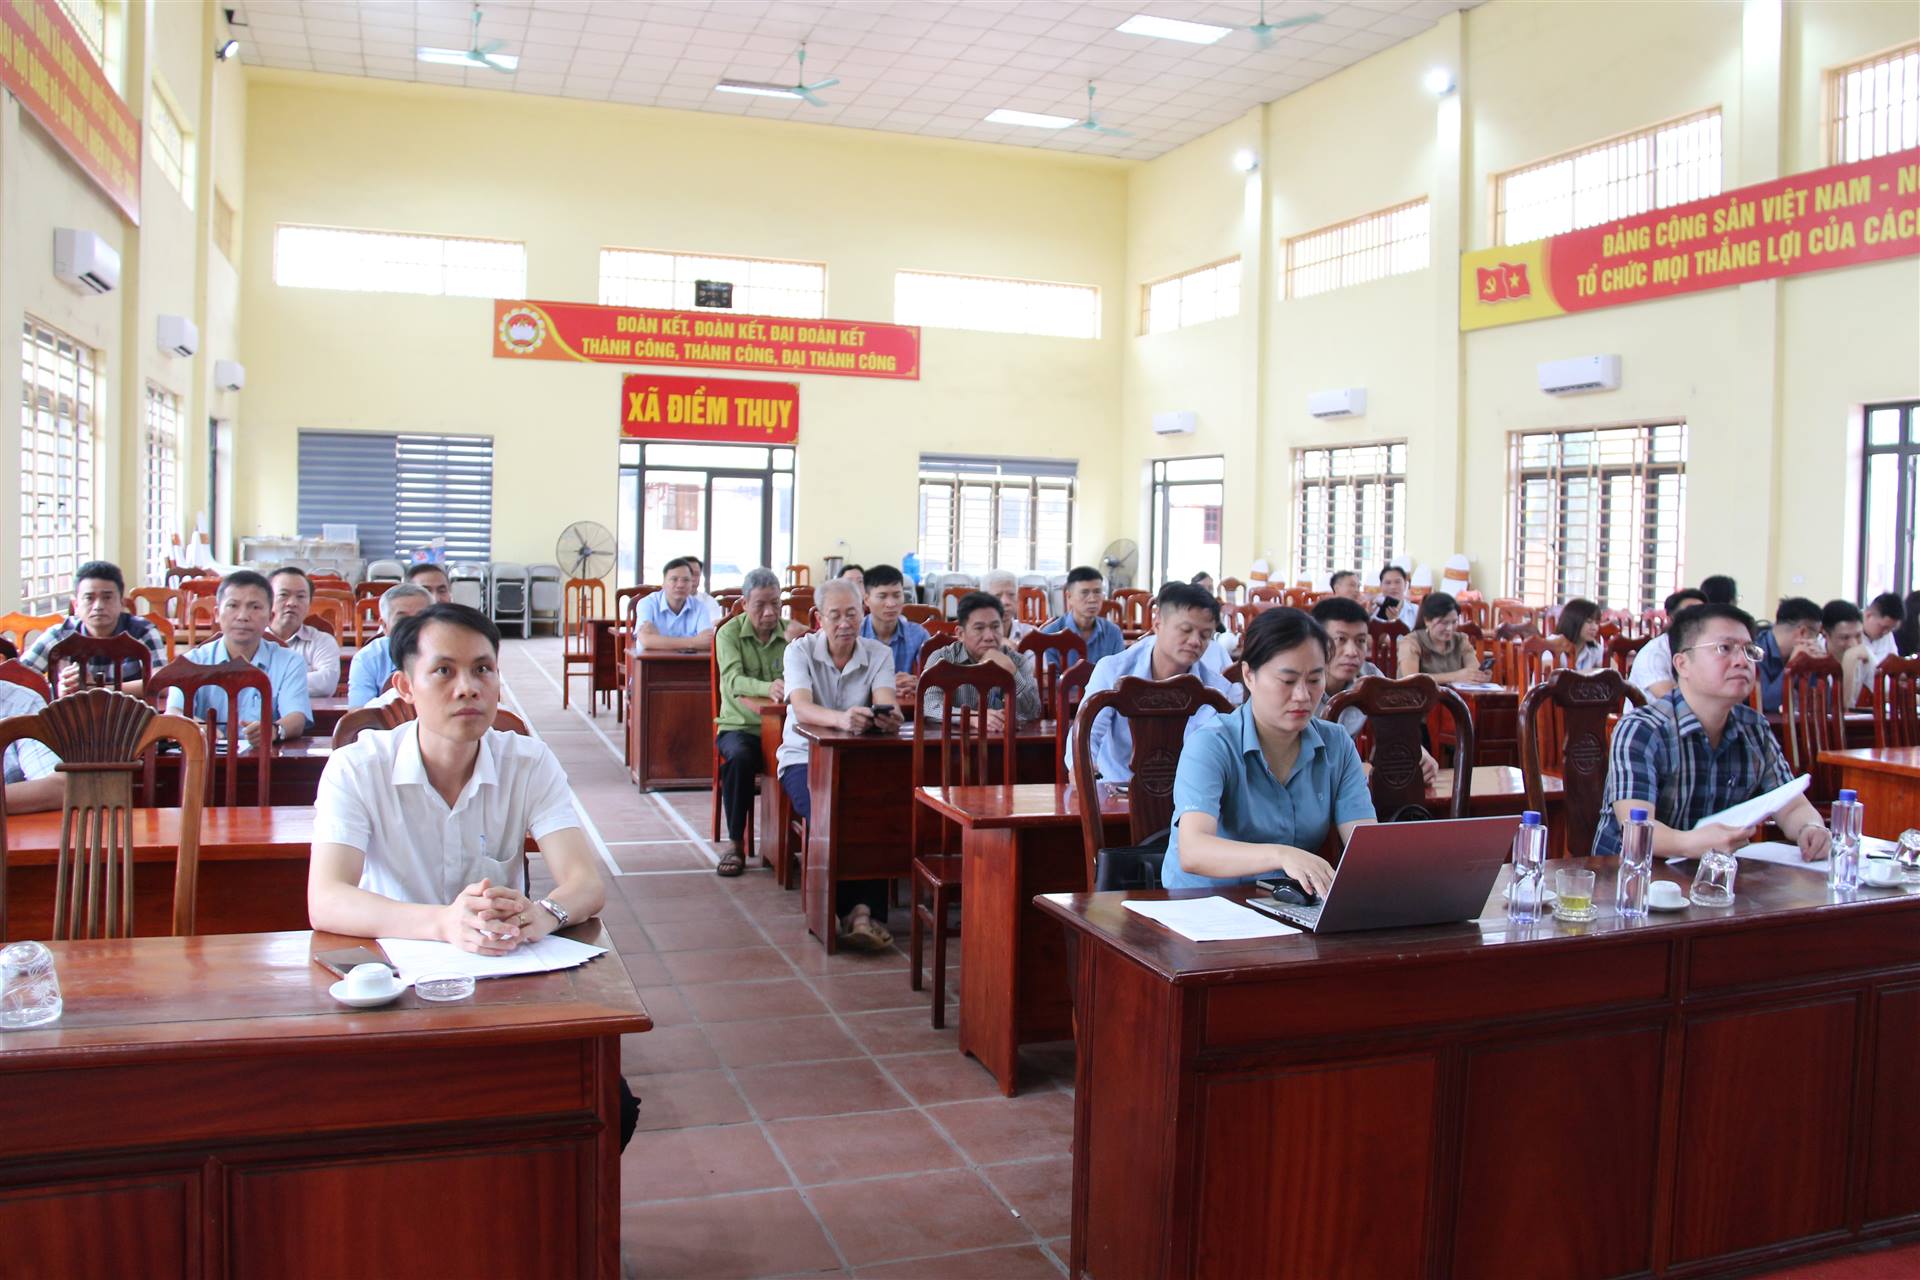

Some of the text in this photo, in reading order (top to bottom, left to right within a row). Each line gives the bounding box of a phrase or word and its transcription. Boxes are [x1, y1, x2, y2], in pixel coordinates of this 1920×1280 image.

[1602, 164, 1920, 258] ĐẢNG CỘNG SẢN VIỆT NAM - N
[1577, 263, 1598, 297] TỔ
[1601, 260, 1648, 293] CHỨC
[1653, 254, 1689, 285] MỌI
[1694, 236, 1761, 276] THẮNG
[1767, 230, 1801, 265] LỢI
[1808, 215, 1857, 255] CỦA
[582, 335, 897, 371] THÀNH CÔNG, THÀNH CÔNG, ĐẠI THÀNH CÔNG
[616, 314, 866, 347] ĐOÀN KẾT, ĐOÀN KẾT, ĐẠI ĐOÀN KẾT
[627, 385, 793, 433] XÃ ĐIỂM THỤY
